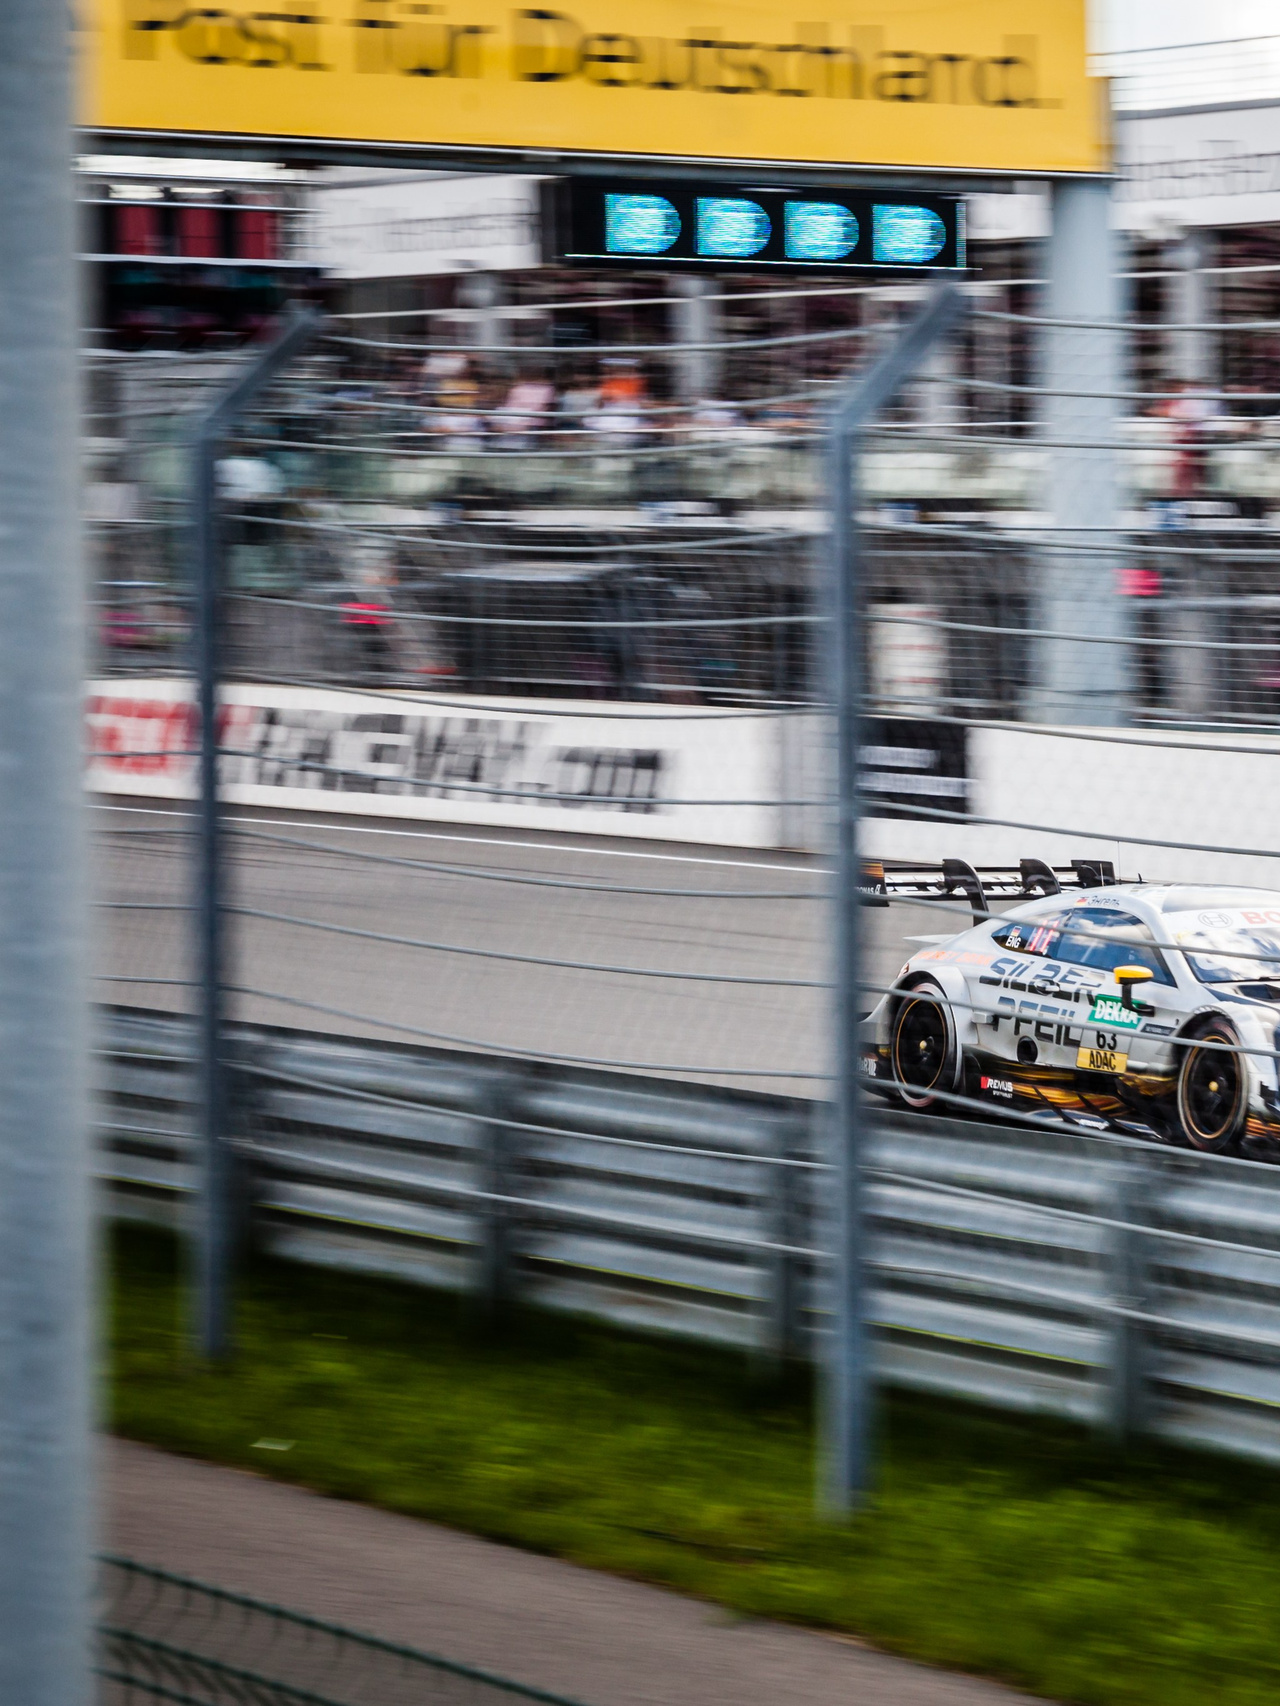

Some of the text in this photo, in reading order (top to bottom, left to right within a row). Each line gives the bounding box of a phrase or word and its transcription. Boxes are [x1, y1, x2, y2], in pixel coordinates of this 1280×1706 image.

[1005, 935, 1021, 949] ENG
[979, 957, 1106, 1007] SILBER
[993, 996, 1081, 1047] PFEIL
[1094, 999, 1139, 1025] DEKRA
[1096, 1029, 1118, 1051] 63
[1088, 1050, 1117, 1071] ADAC
[987, 1078, 1014, 1092] REMUS
